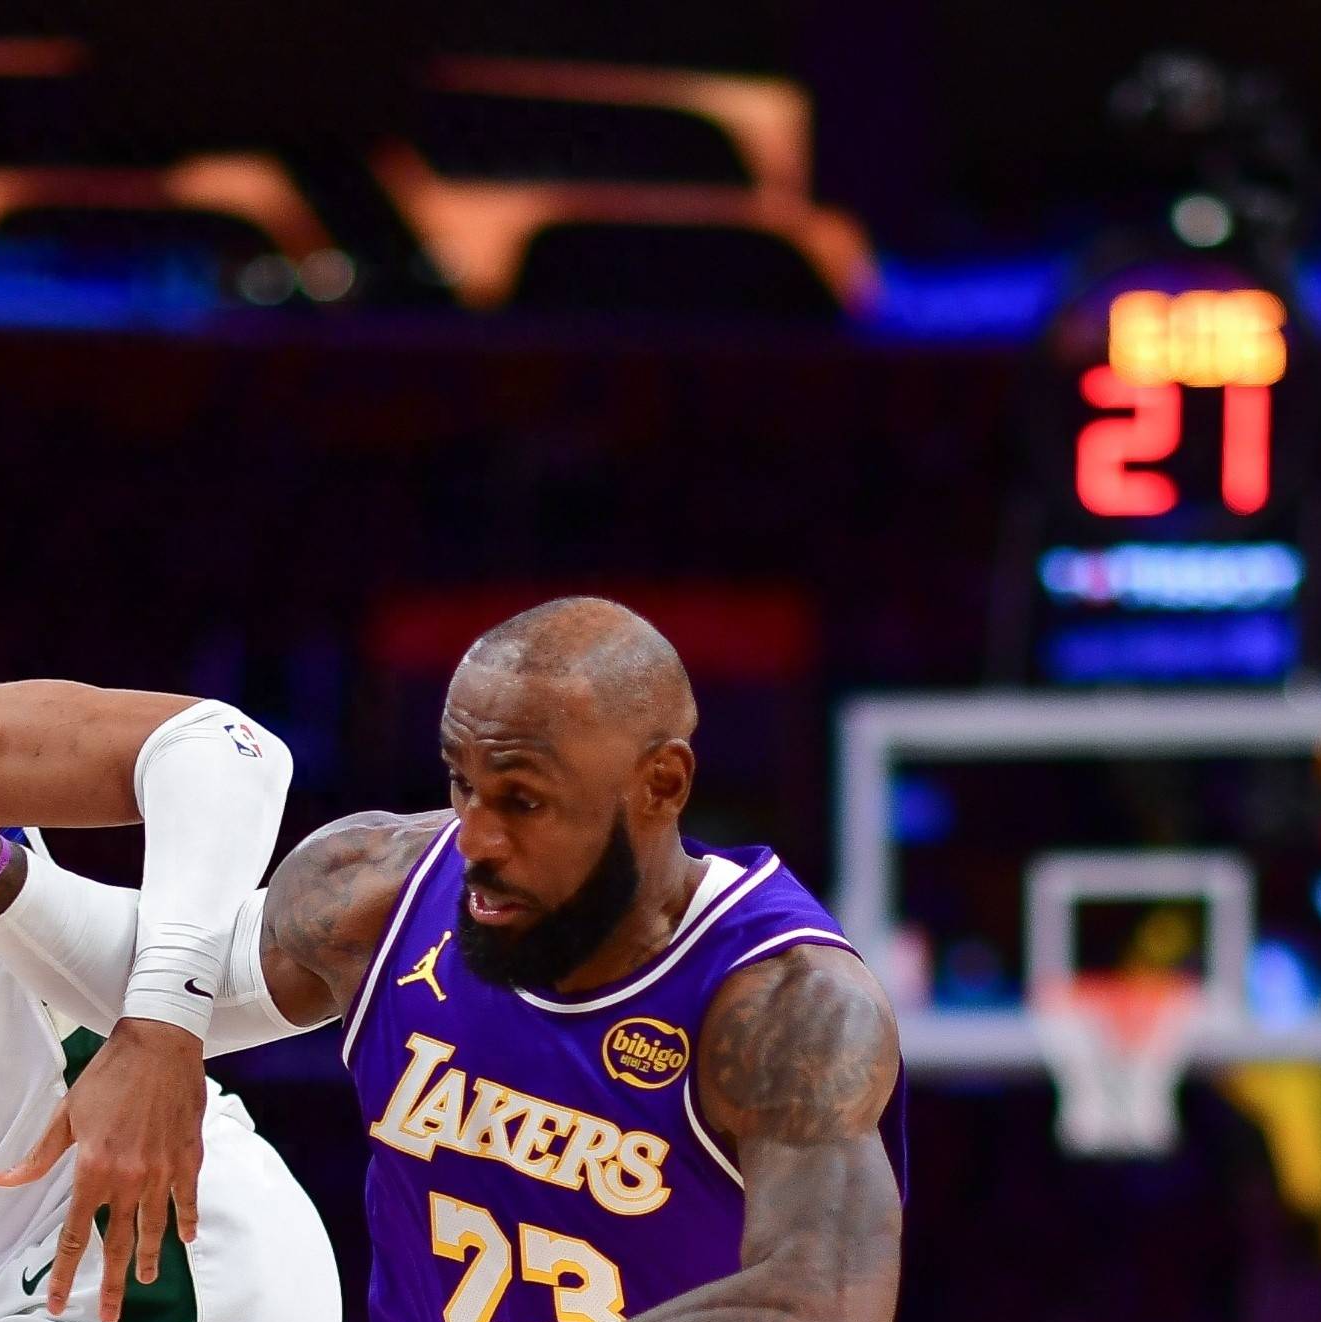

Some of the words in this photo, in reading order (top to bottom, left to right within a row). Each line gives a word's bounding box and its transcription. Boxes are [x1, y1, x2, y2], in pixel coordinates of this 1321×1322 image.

[1076, 366, 1271, 516] 21
[369, 1032, 671, 1216] LAKERS
[613, 1029, 684, 1072] bibigo
